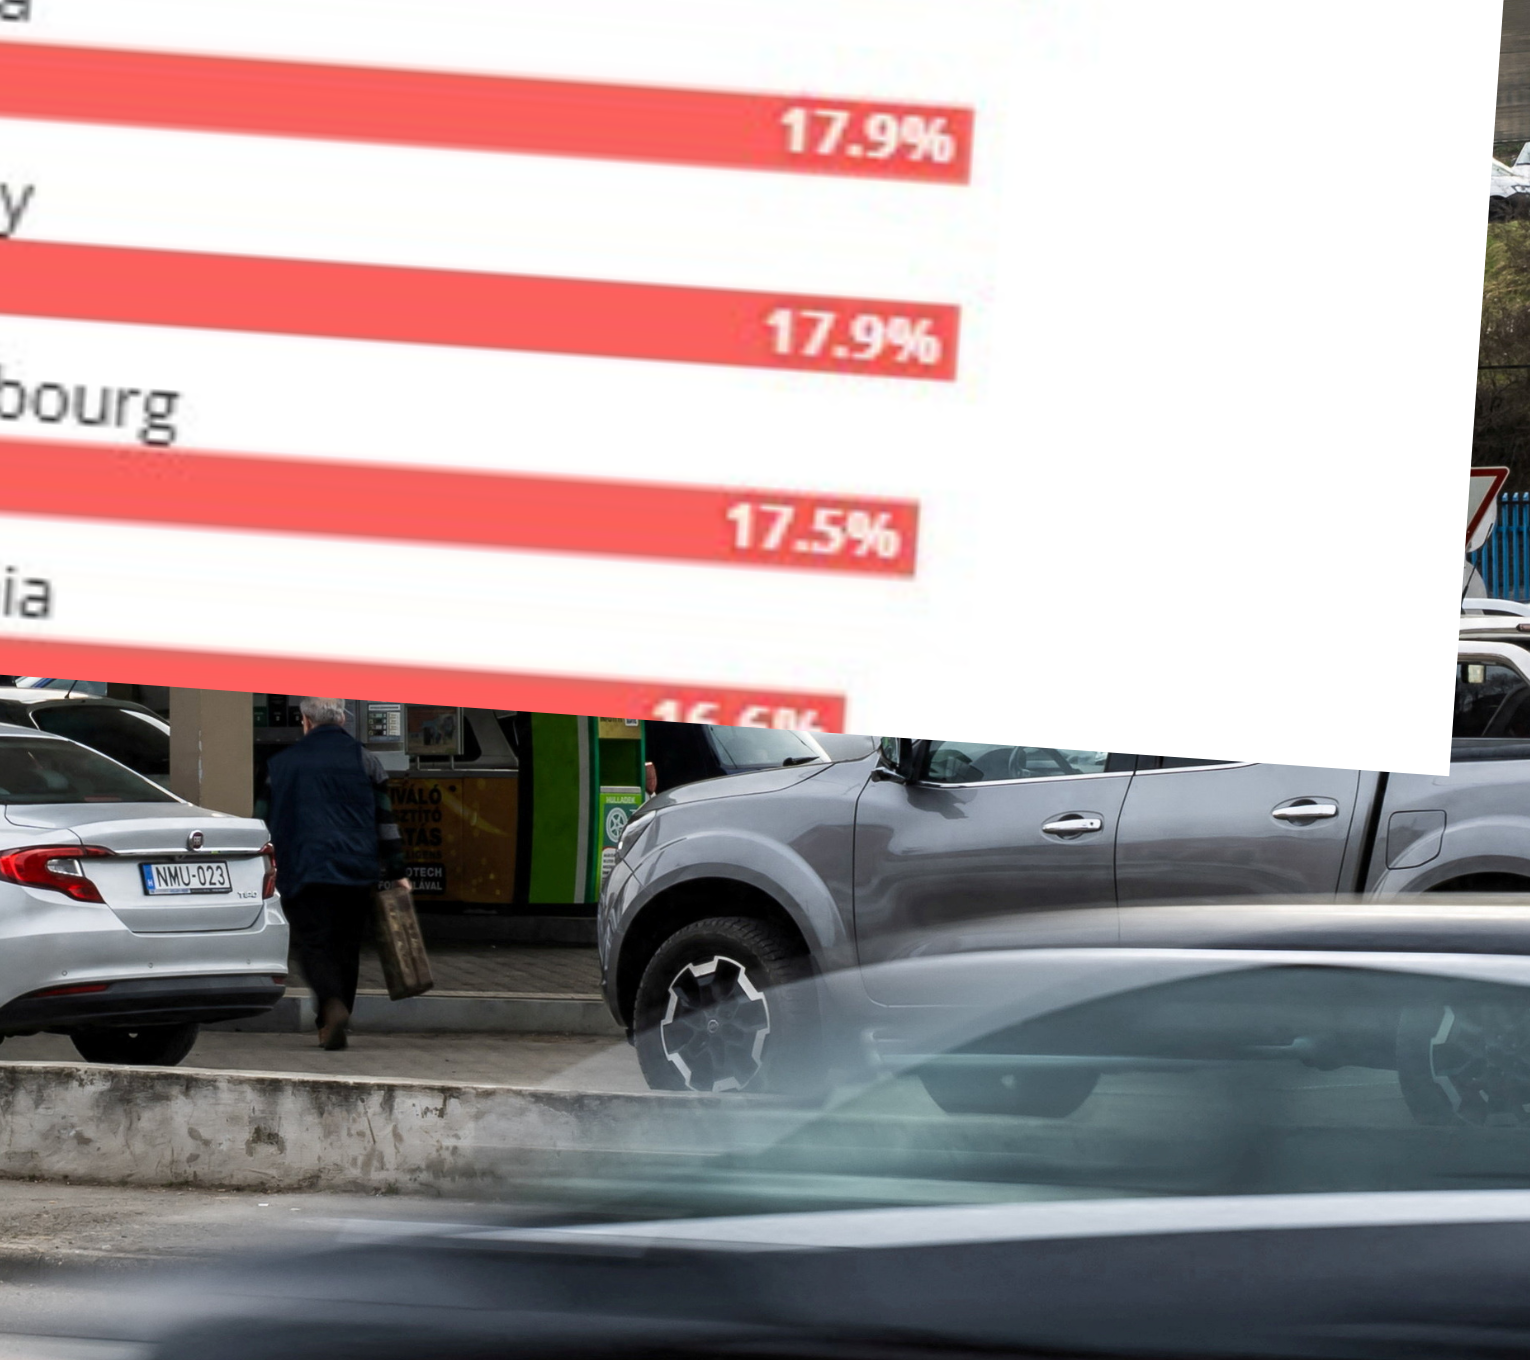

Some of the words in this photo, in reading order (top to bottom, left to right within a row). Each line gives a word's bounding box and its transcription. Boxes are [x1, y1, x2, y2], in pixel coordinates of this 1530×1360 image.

[391, 783, 442, 805] IVÁLÓ
[155, 865, 226, 888] NMU-023
[405, 867, 443, 878] OTECH
